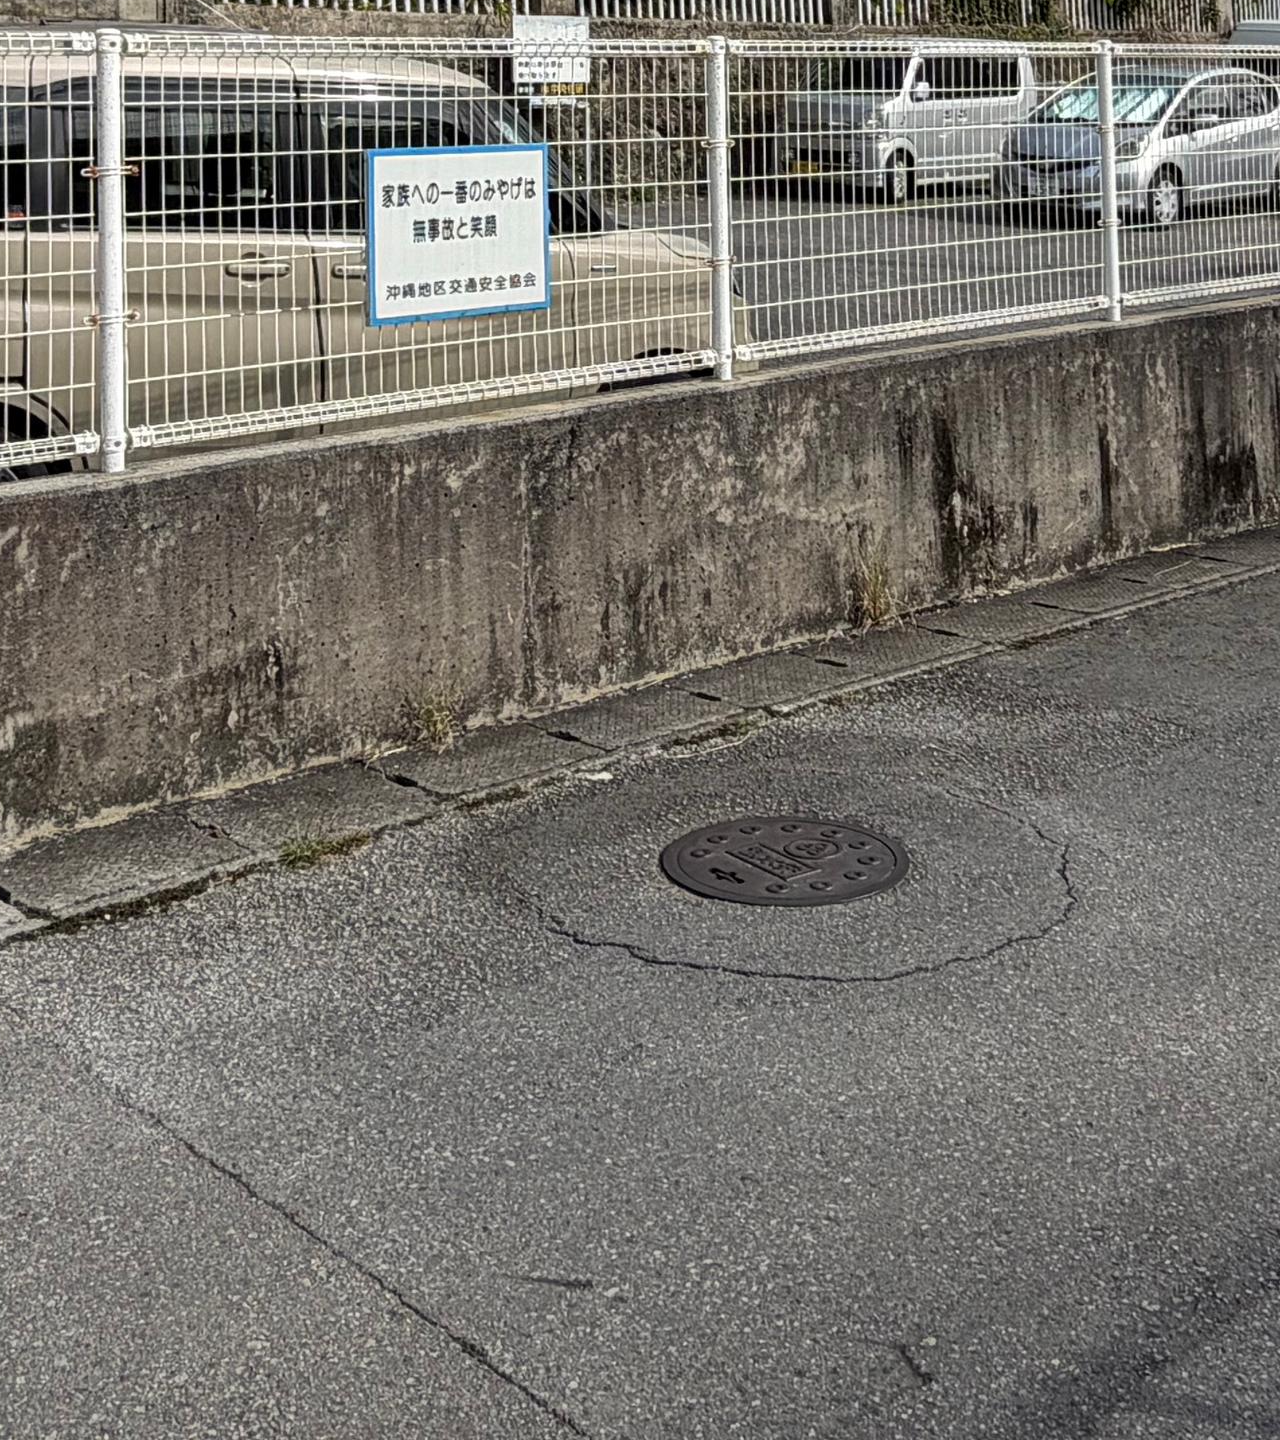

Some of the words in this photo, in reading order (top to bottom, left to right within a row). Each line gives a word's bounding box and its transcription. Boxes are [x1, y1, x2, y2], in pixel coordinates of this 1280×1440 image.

[382, 177, 537, 208] 家族への一番のみやげは
[413, 215, 498, 243] 無事故と笑顔
[386, 273, 537, 300] 沖縄地区交通安全協会
